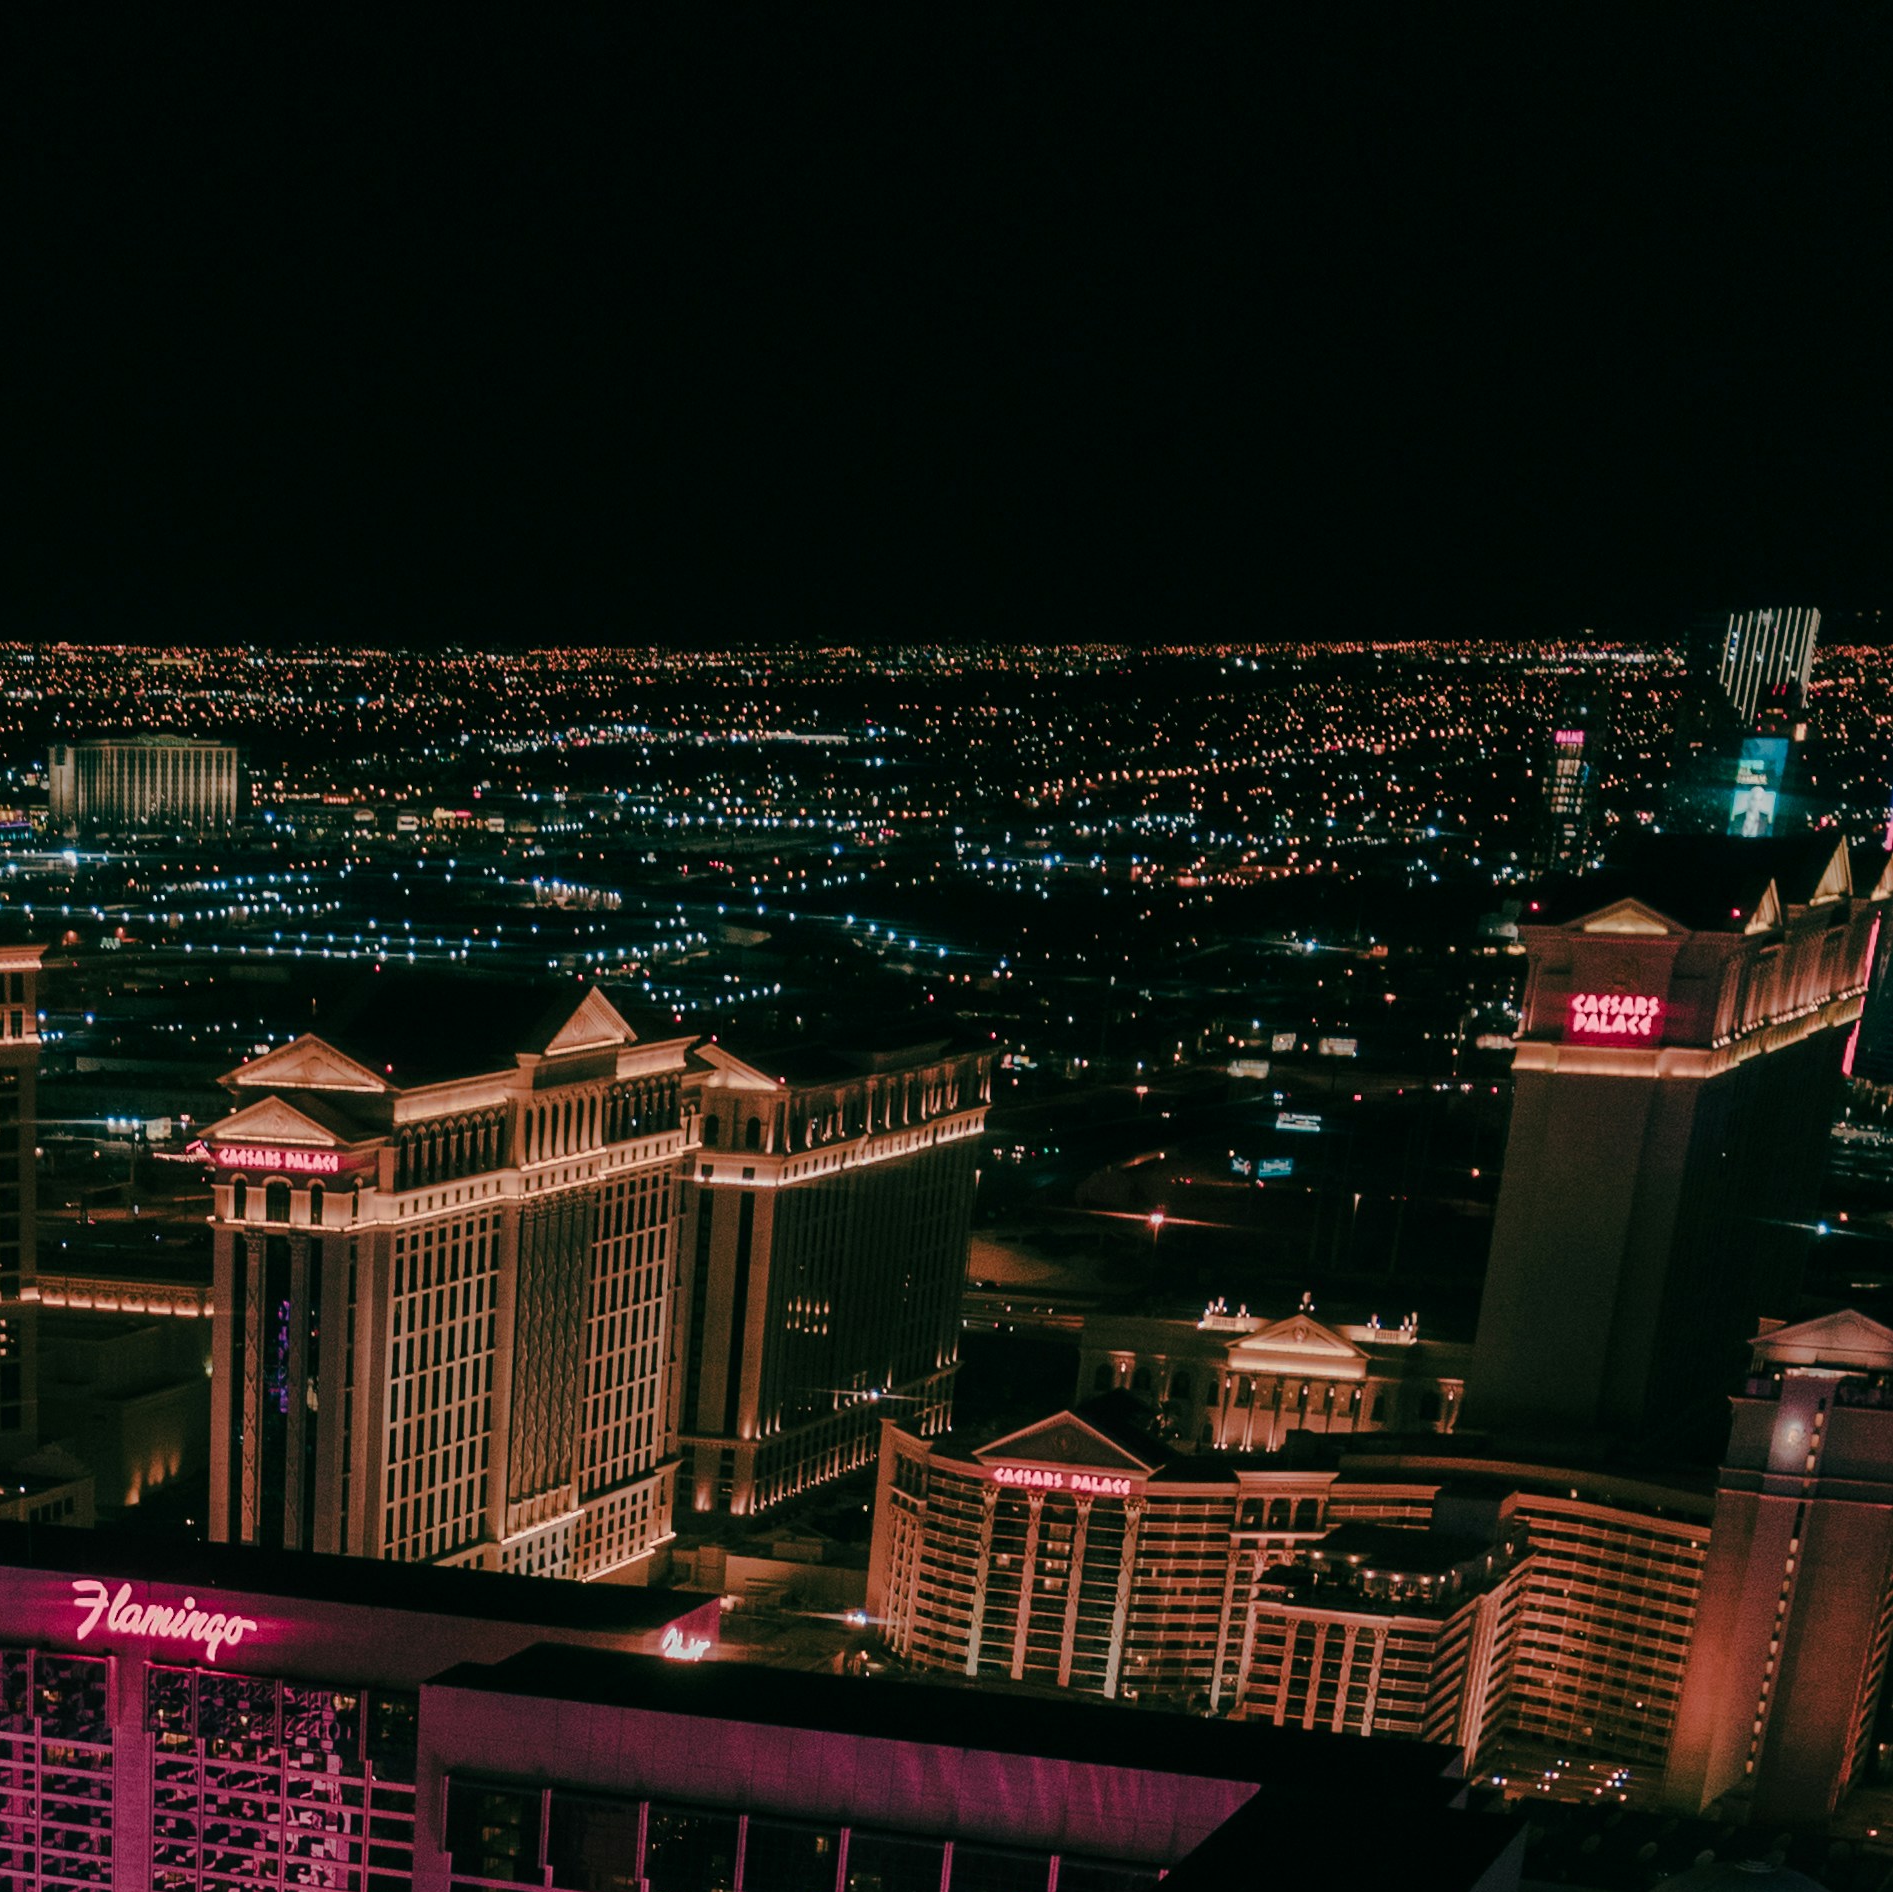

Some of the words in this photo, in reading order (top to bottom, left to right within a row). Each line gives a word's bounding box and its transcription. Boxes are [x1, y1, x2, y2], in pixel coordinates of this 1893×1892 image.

[1572, 993, 1660, 1017] CAESARS
[1573, 1012, 1652, 1036] PALACE
[219, 1148, 282, 1168] CAESARS
[285, 1151, 339, 1173] PALACE
[993, 1467, 1064, 1489] CAESARS
[1070, 1474, 1132, 1496] PALACE
[71, 1579, 258, 1662] Flamingo
